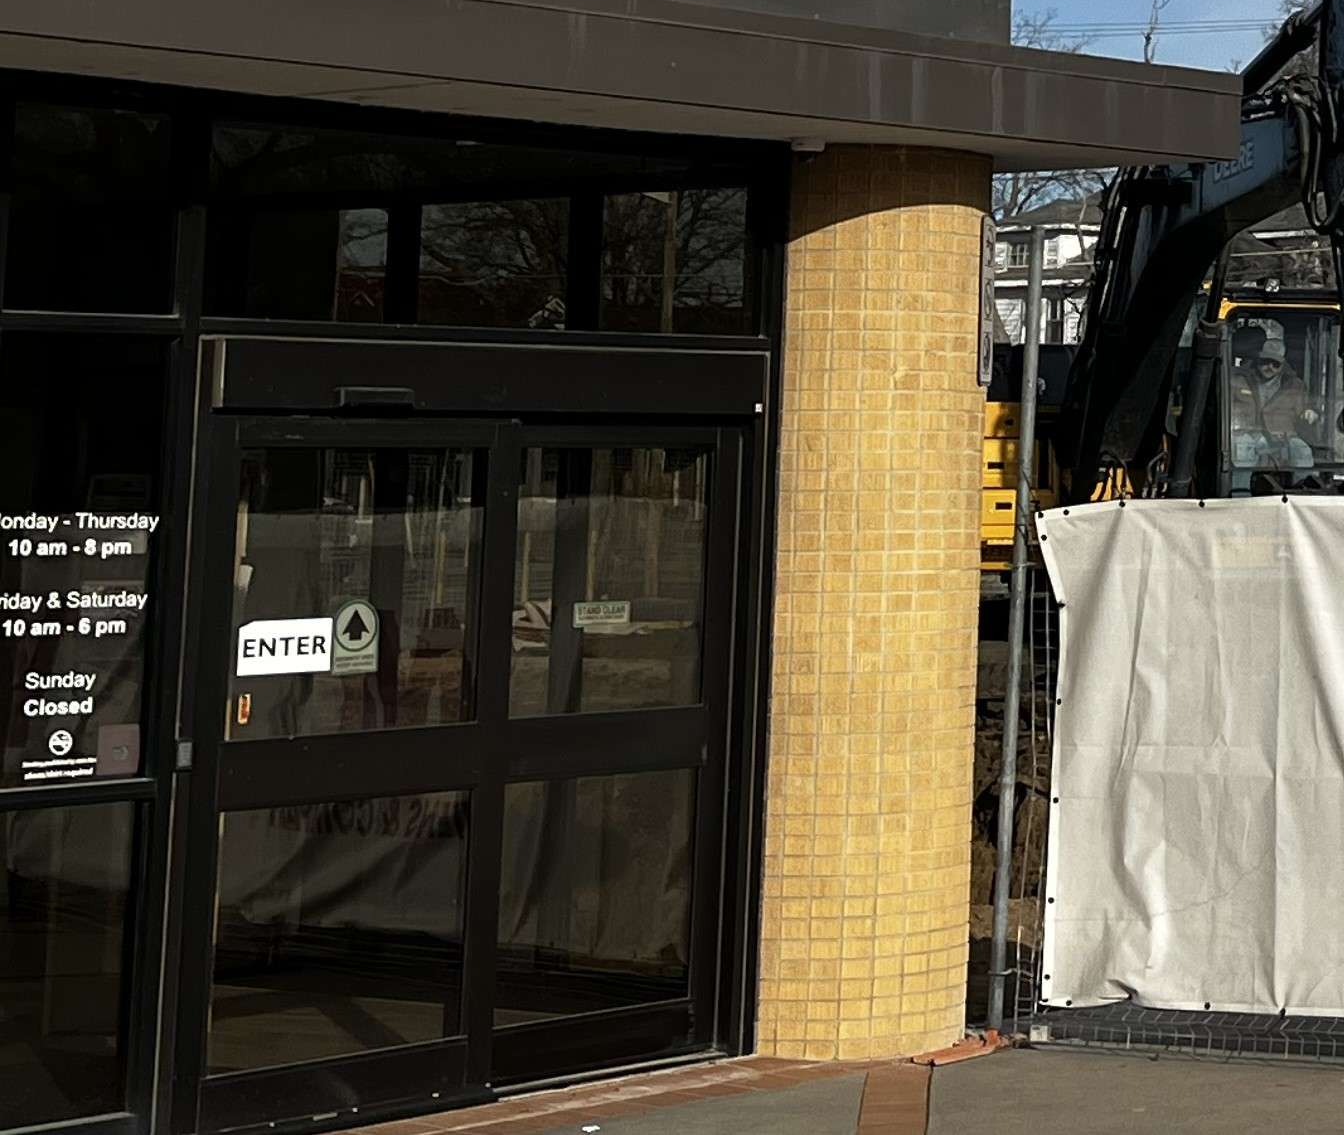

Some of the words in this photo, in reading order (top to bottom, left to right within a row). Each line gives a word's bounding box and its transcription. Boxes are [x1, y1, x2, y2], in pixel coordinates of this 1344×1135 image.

[0, 512, 59, 533] onday
[75, 512, 160, 533] Thursday
[8, 539, 32, 556] 10
[36, 541, 67, 556] am
[84, 538, 97, 556] 8
[101, 541, 132, 559] pm
[0, 592, 43, 613] riday
[46, 591, 61, 609] &
[66, 590, 149, 610] Saturday
[2, 619, 26, 637] 10
[30, 621, 61, 636] am
[78, 617, 91, 635] 6
[95, 619, 126, 637] pm
[243, 635, 326, 658] ENTER
[25, 671, 96, 691] Sunday
[24, 697, 93, 716] Closed
